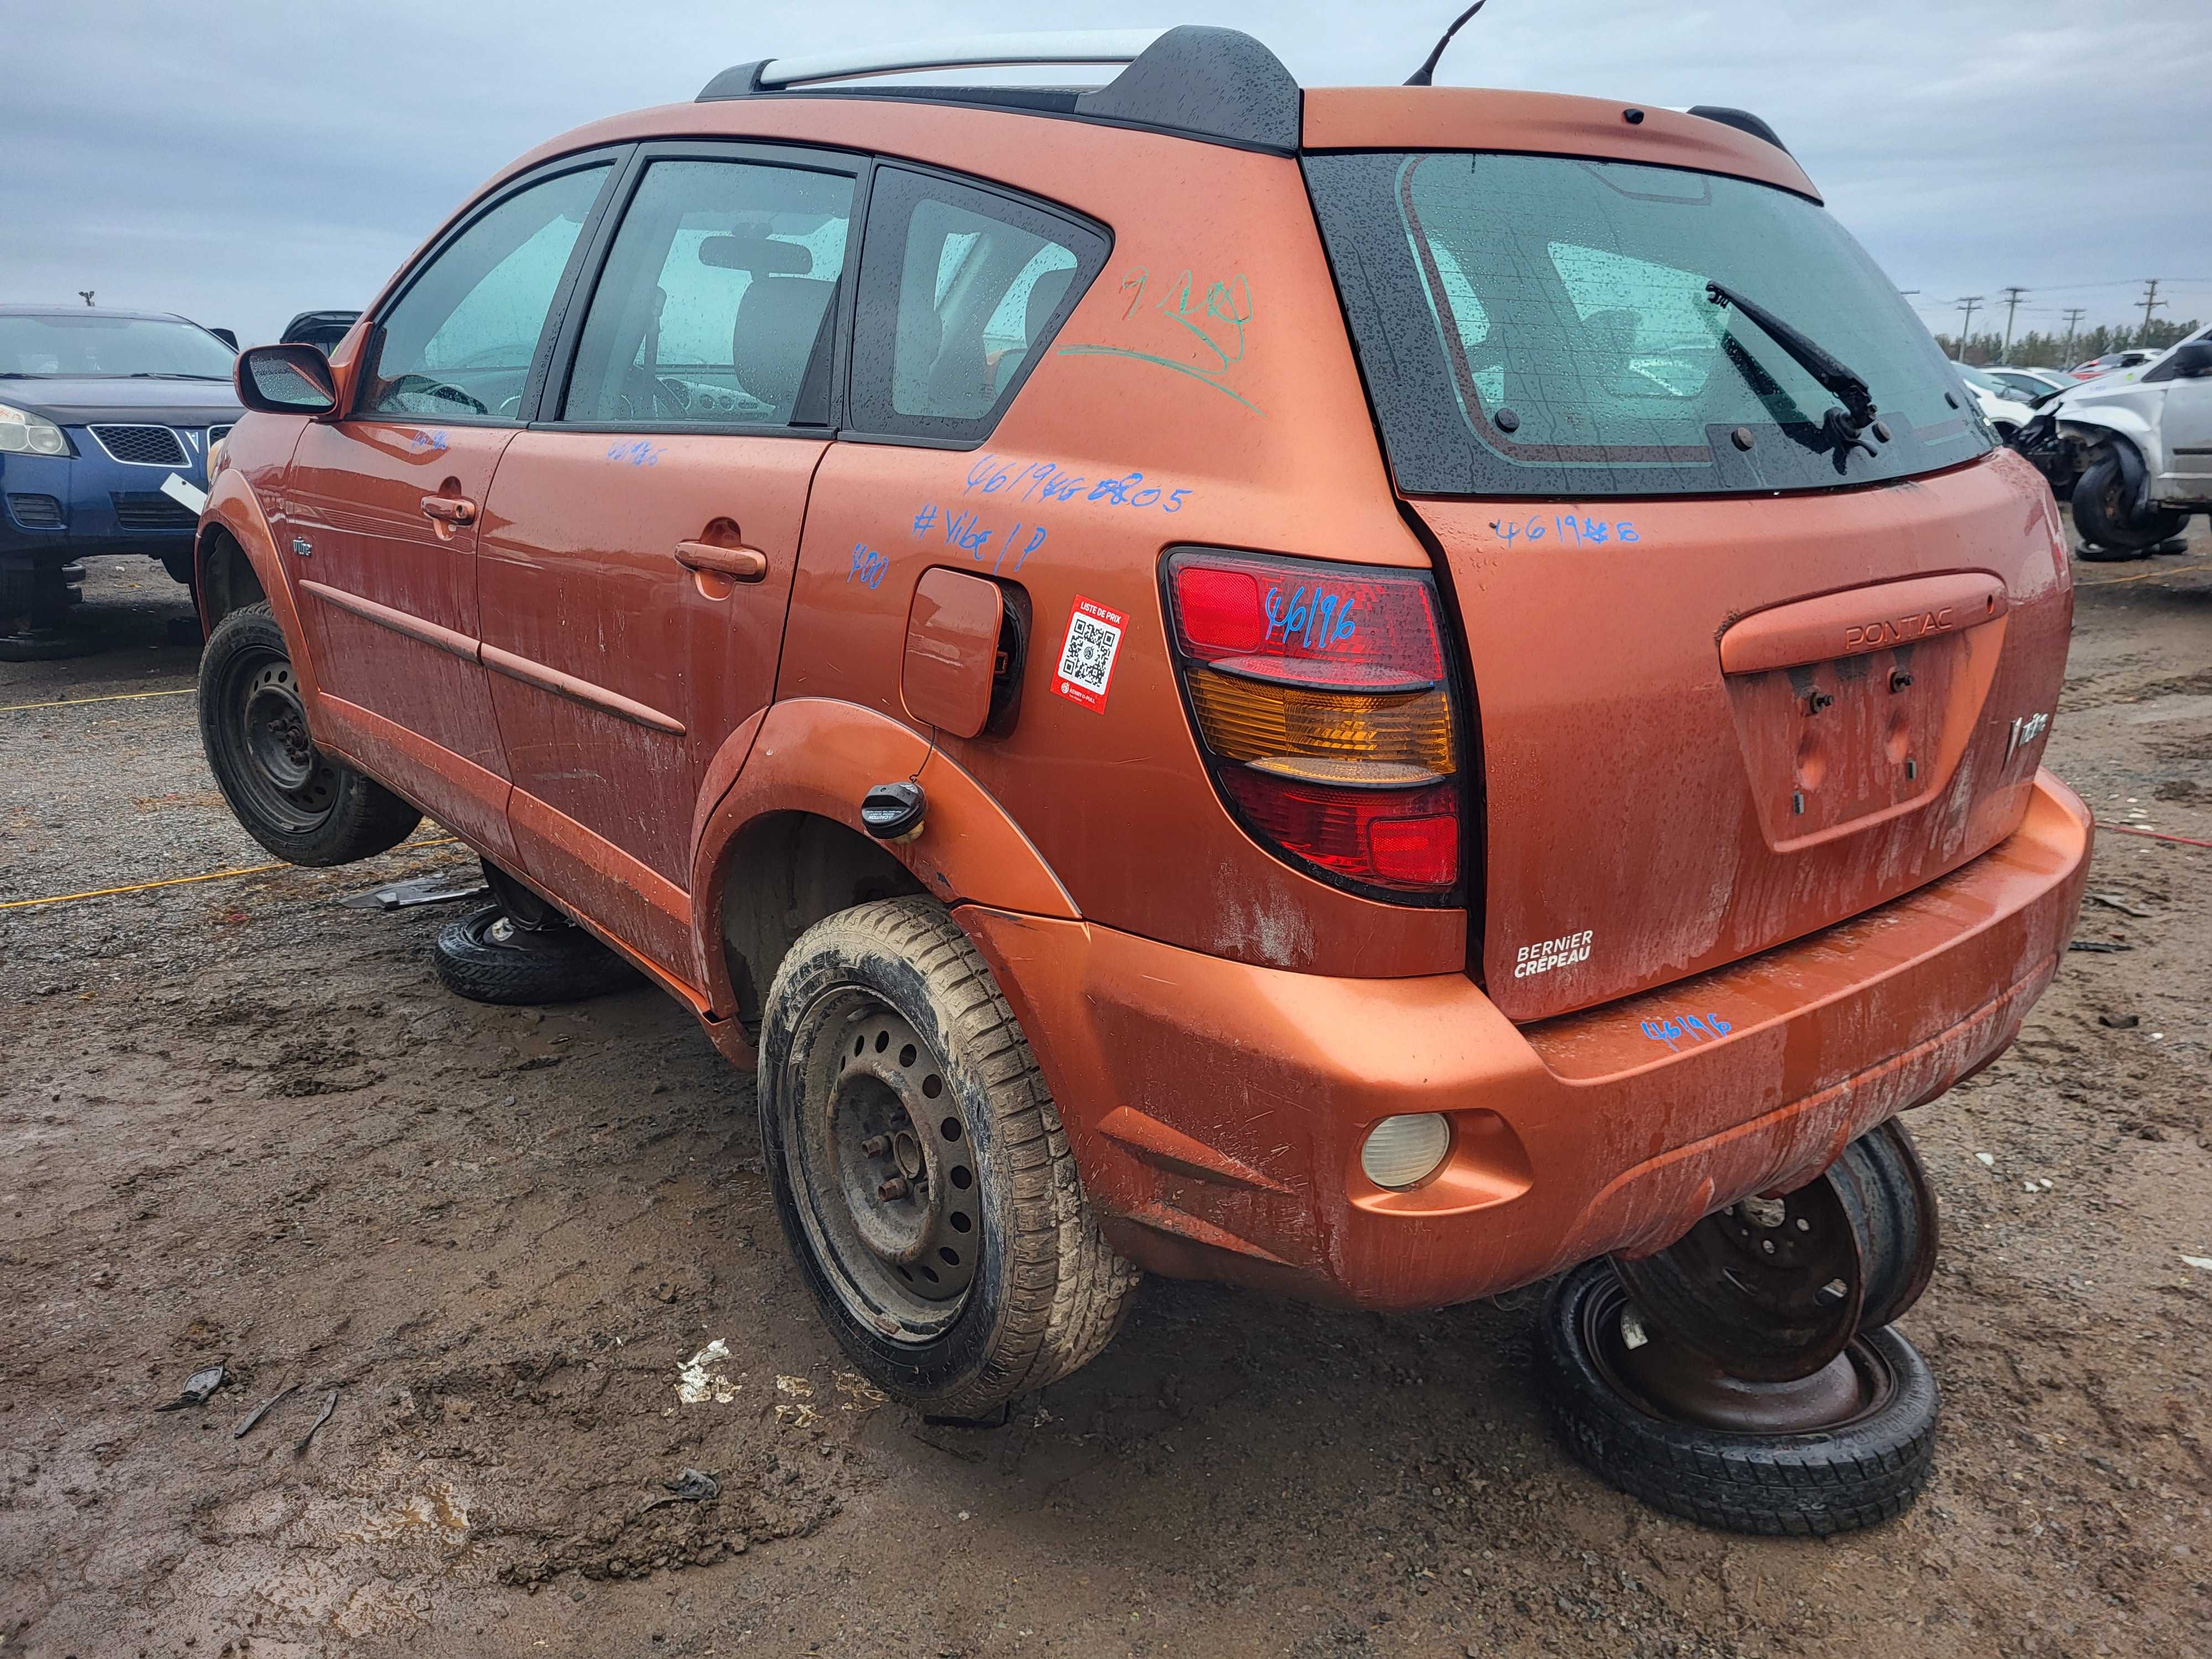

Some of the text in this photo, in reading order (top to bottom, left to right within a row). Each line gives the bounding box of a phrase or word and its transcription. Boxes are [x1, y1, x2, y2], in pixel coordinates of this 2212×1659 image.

[1080, 601, 1122, 624] LISTE DE PRIX
[1264, 586, 1356, 649] 46196
[1845, 607, 1953, 650] PONTIAC
[1640, 1013, 1731, 1053] 46196
